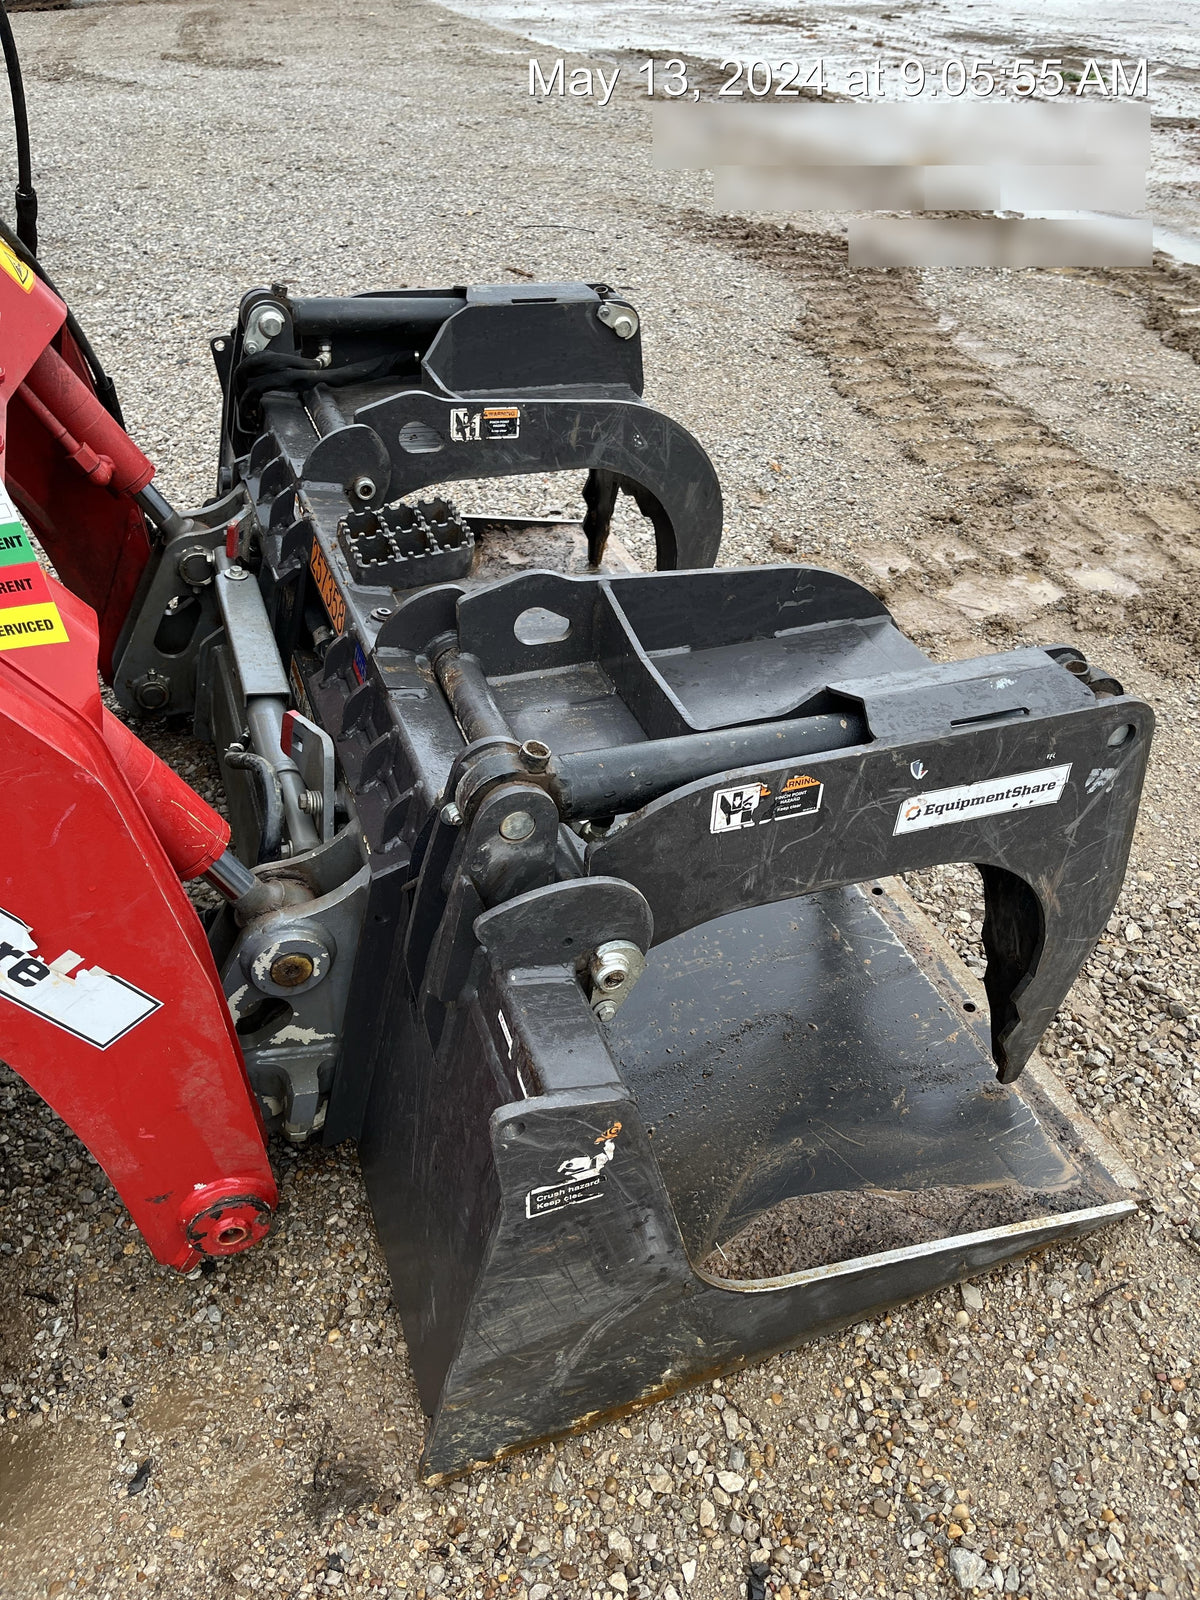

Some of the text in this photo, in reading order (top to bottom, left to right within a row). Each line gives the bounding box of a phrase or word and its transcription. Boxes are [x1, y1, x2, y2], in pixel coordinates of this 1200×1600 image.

[923, 780, 1057, 816] EquipmentShare
[536, 1178, 600, 1202] Crush hazard
[536, 1198, 561, 1210] Keep
